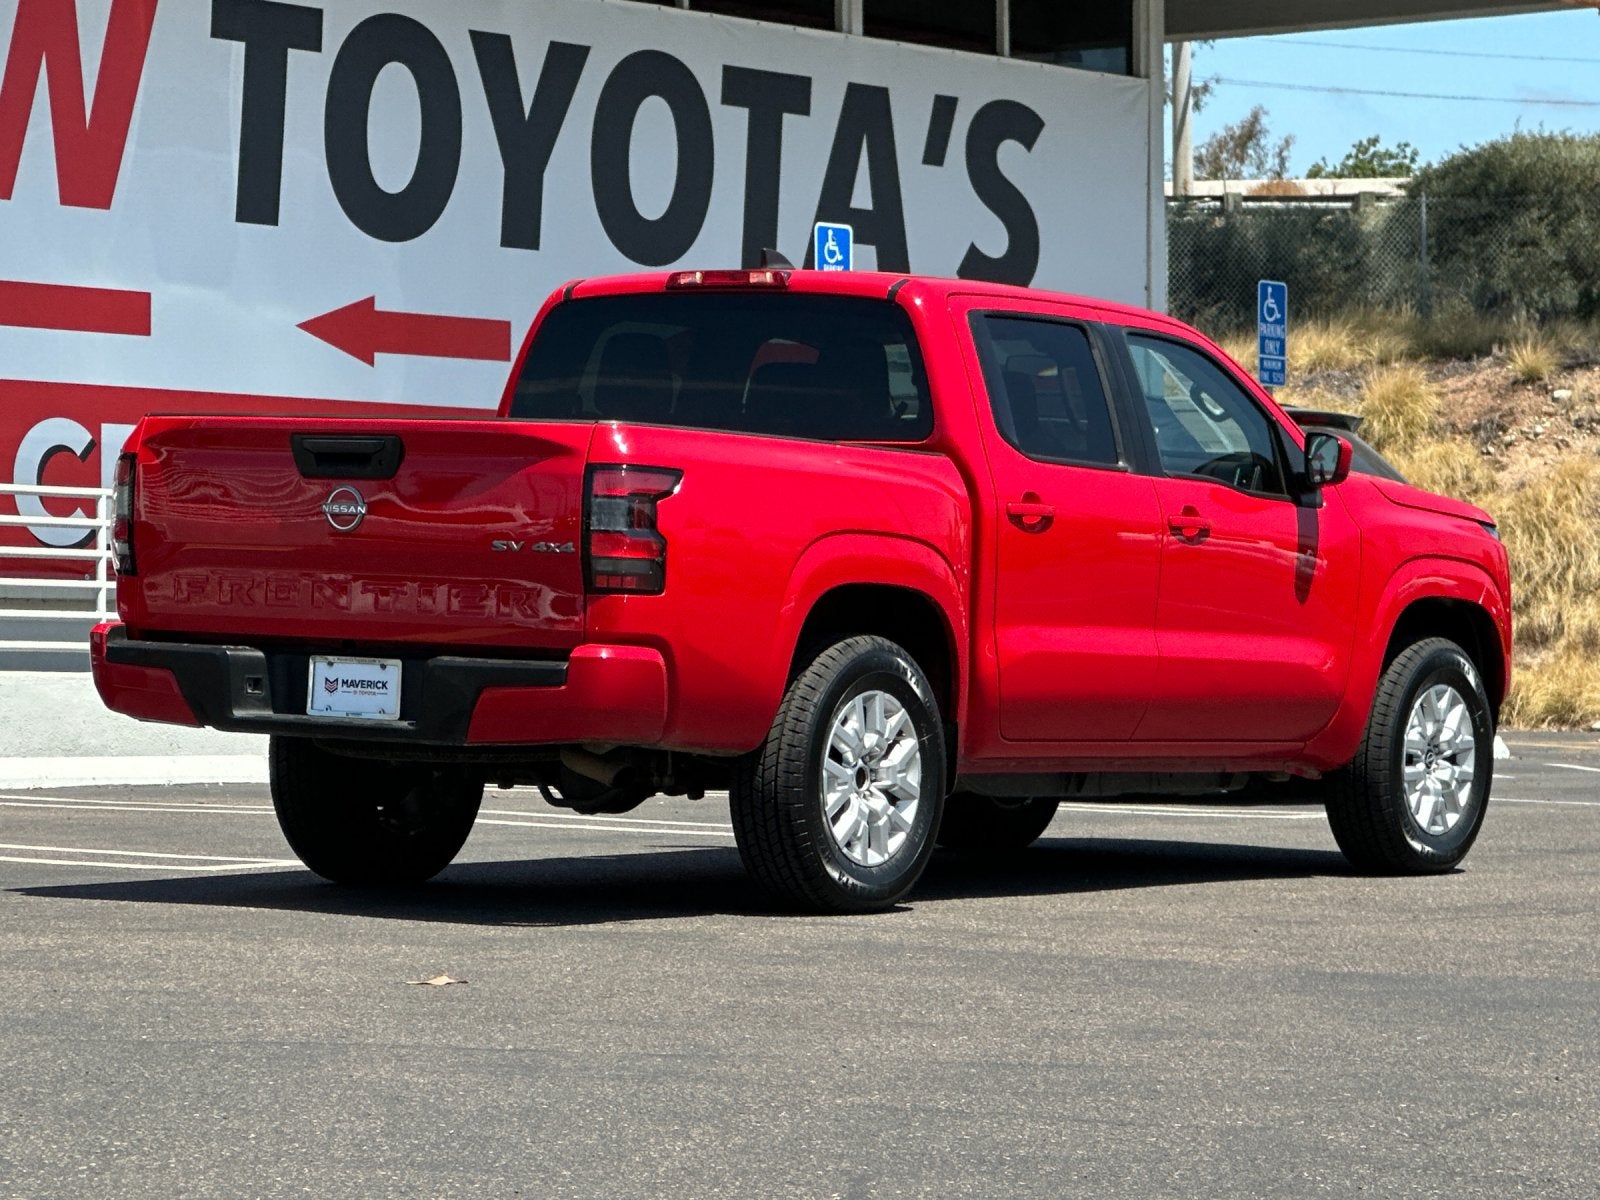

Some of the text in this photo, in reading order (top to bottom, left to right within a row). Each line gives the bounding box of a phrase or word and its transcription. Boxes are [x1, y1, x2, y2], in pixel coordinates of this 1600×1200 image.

[210, 0, 1046, 287] TOYOTA'S
[1260, 323, 1285, 338] PARKING
[1264, 339, 1280, 355] ONLY
[322, 504, 366, 514] NISSAN
[491, 540, 525, 552] SV
[341, 678, 388, 690] MAVERICK
